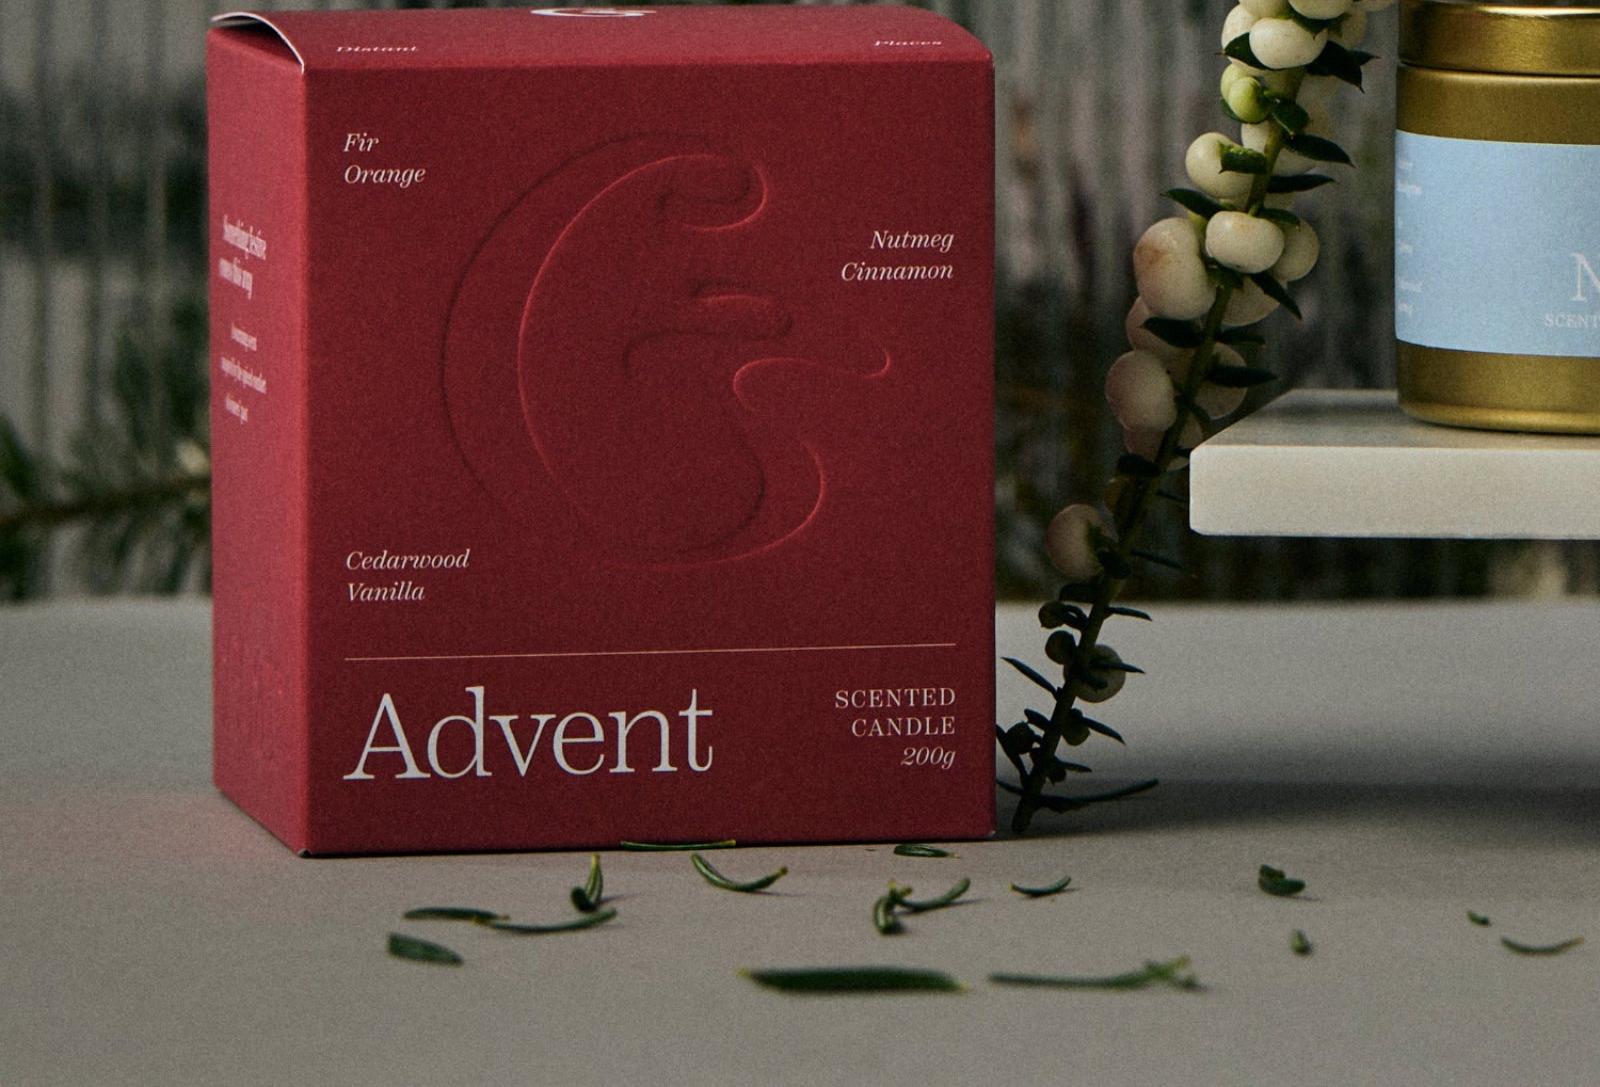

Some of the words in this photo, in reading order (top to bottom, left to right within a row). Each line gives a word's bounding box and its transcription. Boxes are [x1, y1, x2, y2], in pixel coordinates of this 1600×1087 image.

[343, 132, 380, 153] Fir
[344, 164, 427, 189] Orange
[869, 230, 955, 253] Nutmeg
[840, 261, 954, 282] Cinnamon
[345, 548, 471, 571] Cedarwood
[347, 580, 426, 602] Vanilla
[834, 687, 957, 709] SCENTED
[342, 685, 714, 780] Advent
[851, 717, 956, 738] CANDLE
[901, 746, 957, 771] 200g
